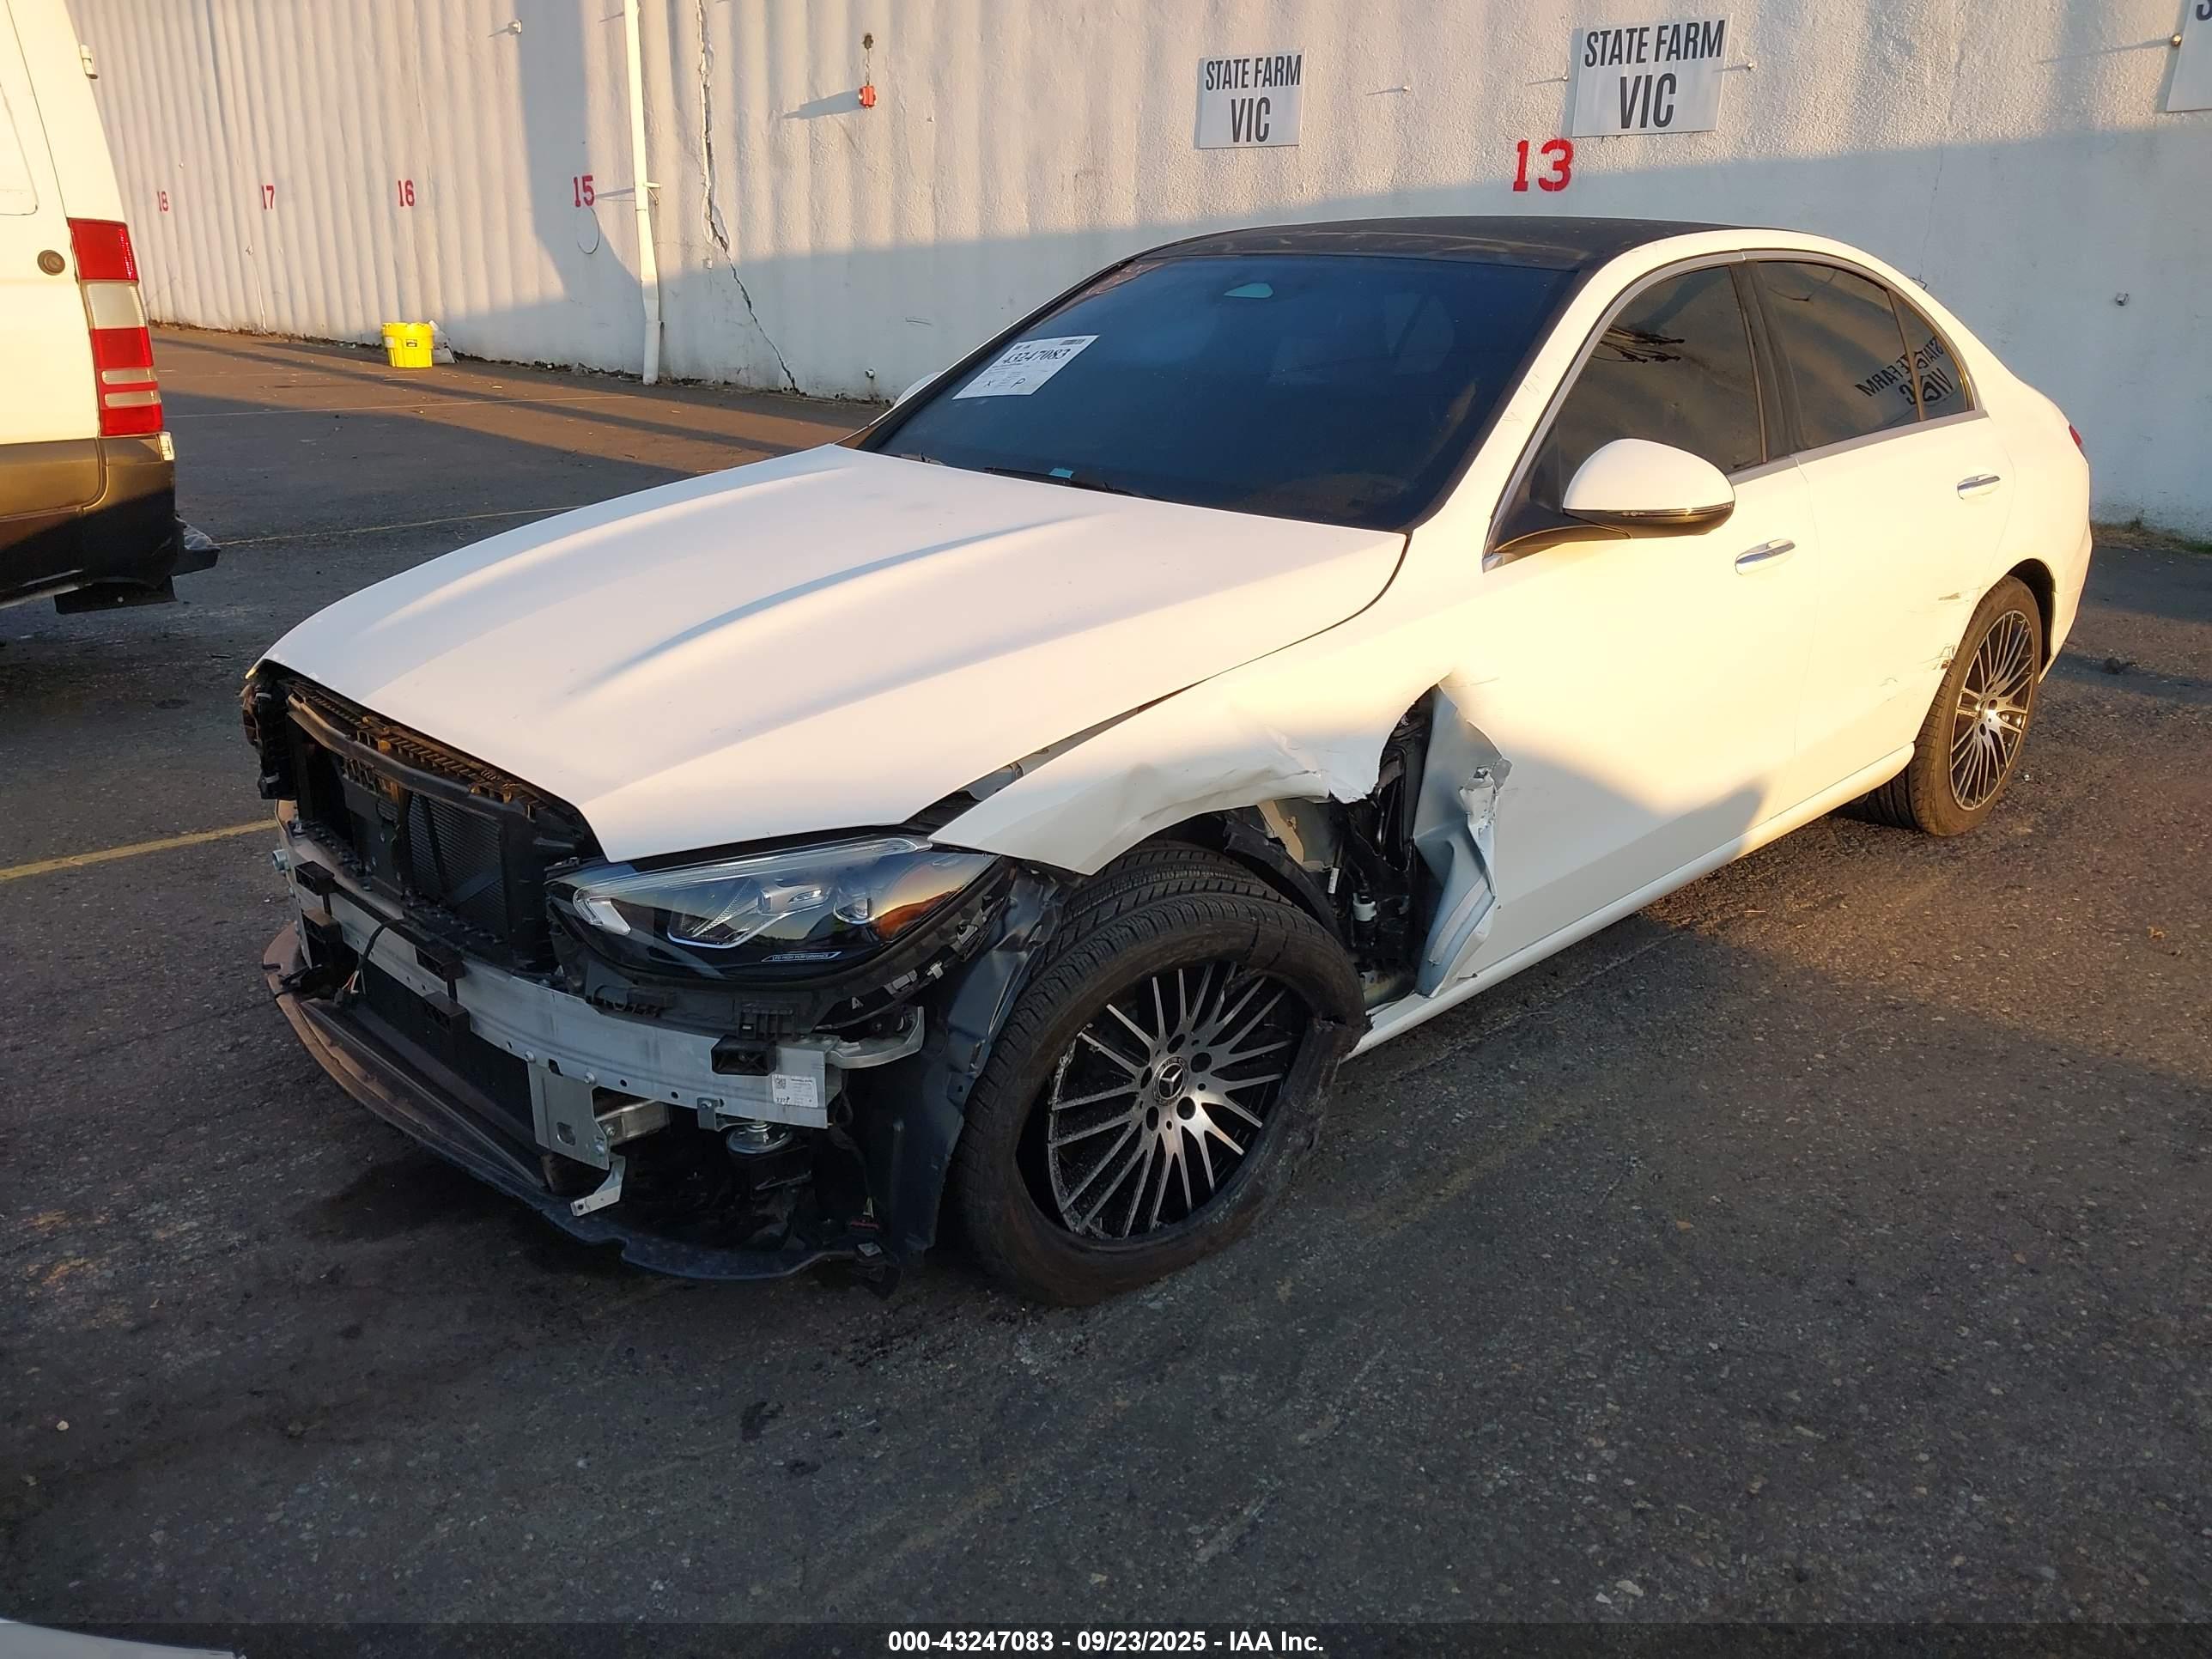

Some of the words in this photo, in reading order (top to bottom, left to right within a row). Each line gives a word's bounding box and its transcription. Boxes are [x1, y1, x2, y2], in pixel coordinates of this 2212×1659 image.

[1584, 26, 1650, 67] STATE
[1654, 20, 1726, 63] FARM
[1206, 58, 1250, 91] STATE
[1254, 54, 1302, 88] FARM
[1620, 72, 1677, 130] VIC
[1231, 96, 1271, 143] VIC
[1512, 137, 1575, 192] 13
[157, 190, 169, 213] 18
[261, 185, 275, 210] 17
[398, 179, 416, 207] 16
[573, 174, 596, 208] 15
[1002, 348, 1072, 364] 43247083
